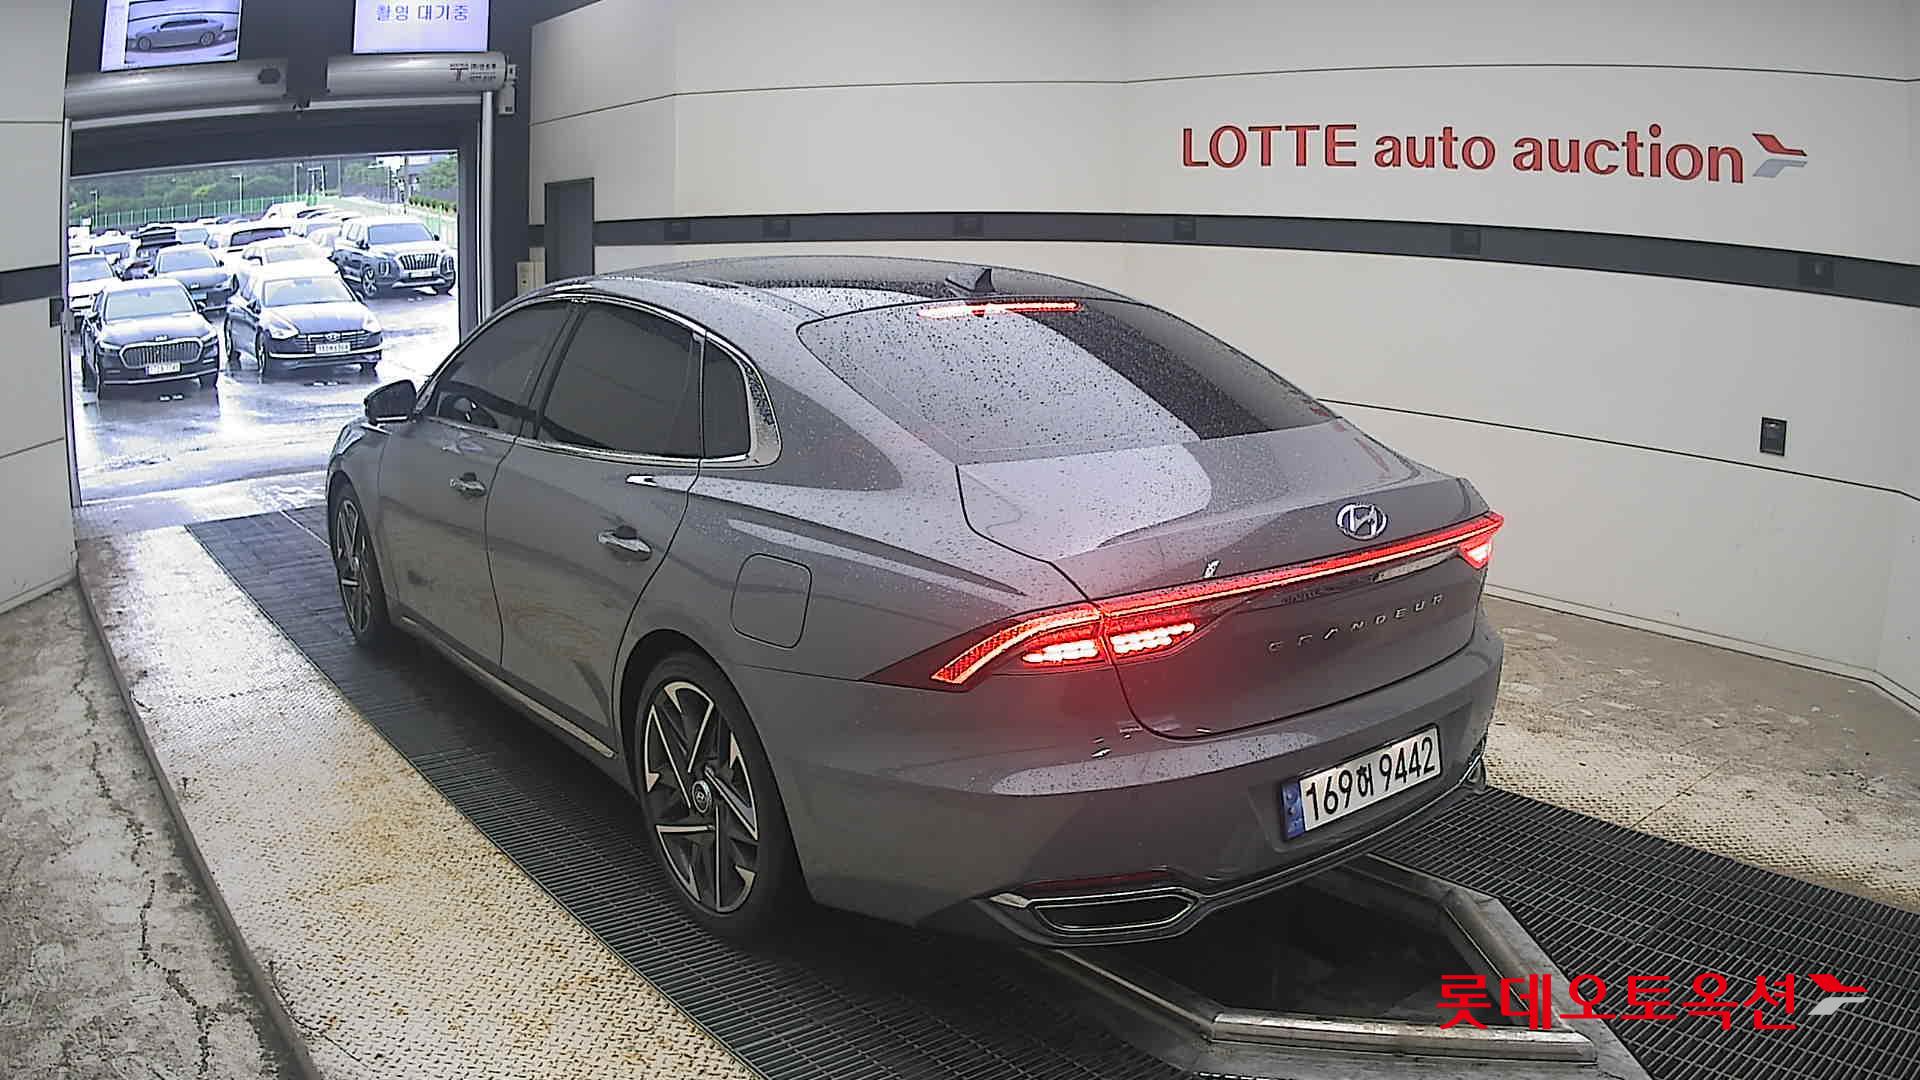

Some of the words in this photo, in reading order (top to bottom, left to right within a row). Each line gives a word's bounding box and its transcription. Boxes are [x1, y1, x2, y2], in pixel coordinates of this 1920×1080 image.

[416, 4, 469, 21] 대기중
[1182, 124, 1357, 168] LOTTE
[1374, 126, 1496, 170] auto
[1512, 123, 1744, 184] auction
[1379, 736, 1436, 791] 9442
